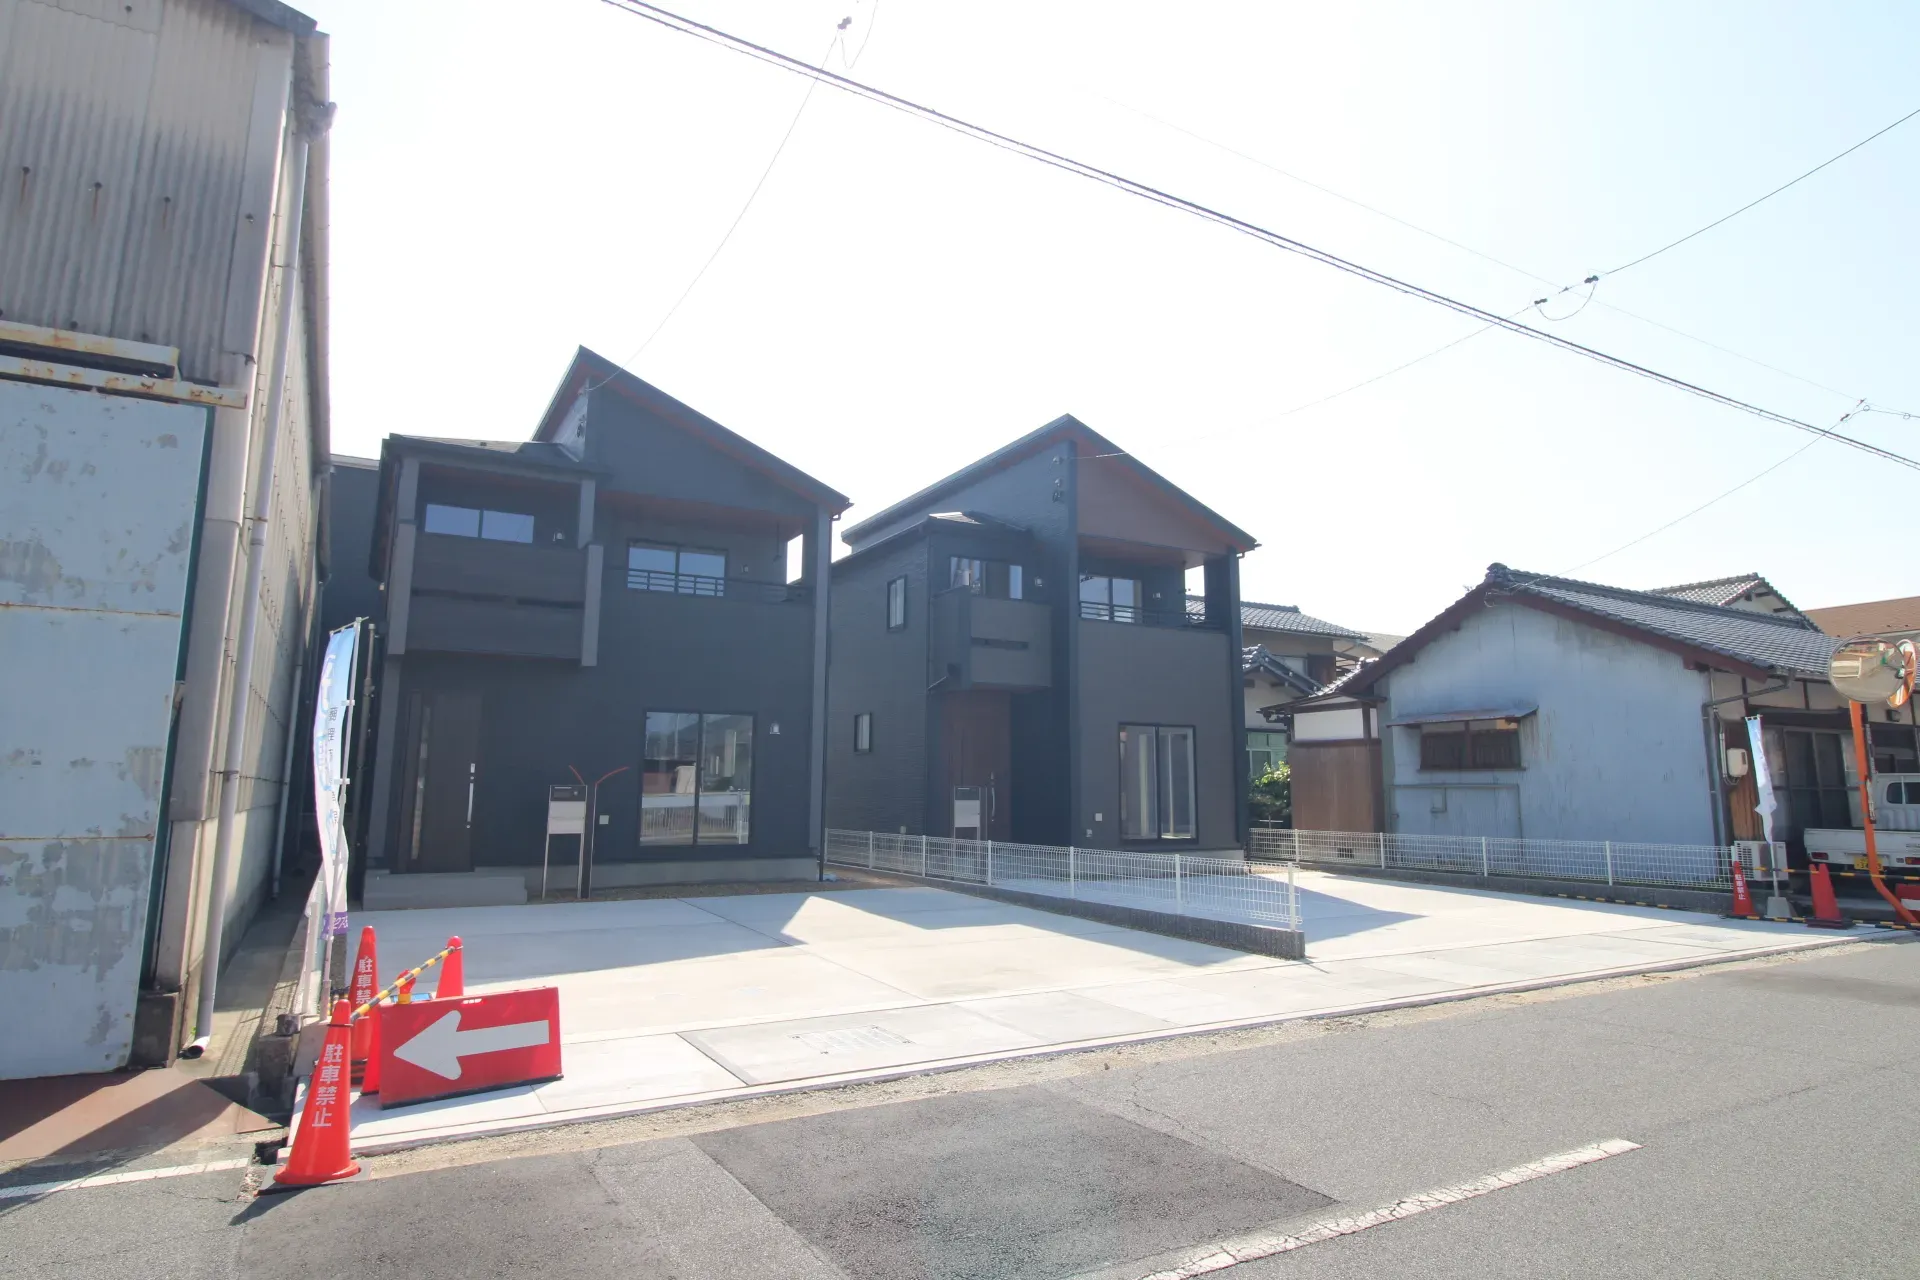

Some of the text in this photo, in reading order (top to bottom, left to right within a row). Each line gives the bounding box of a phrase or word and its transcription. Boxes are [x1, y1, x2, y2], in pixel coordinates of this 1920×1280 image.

[1734, 873, 1746, 900] 駐車禁止
[312, 1043, 344, 1127] 駐車禁止
